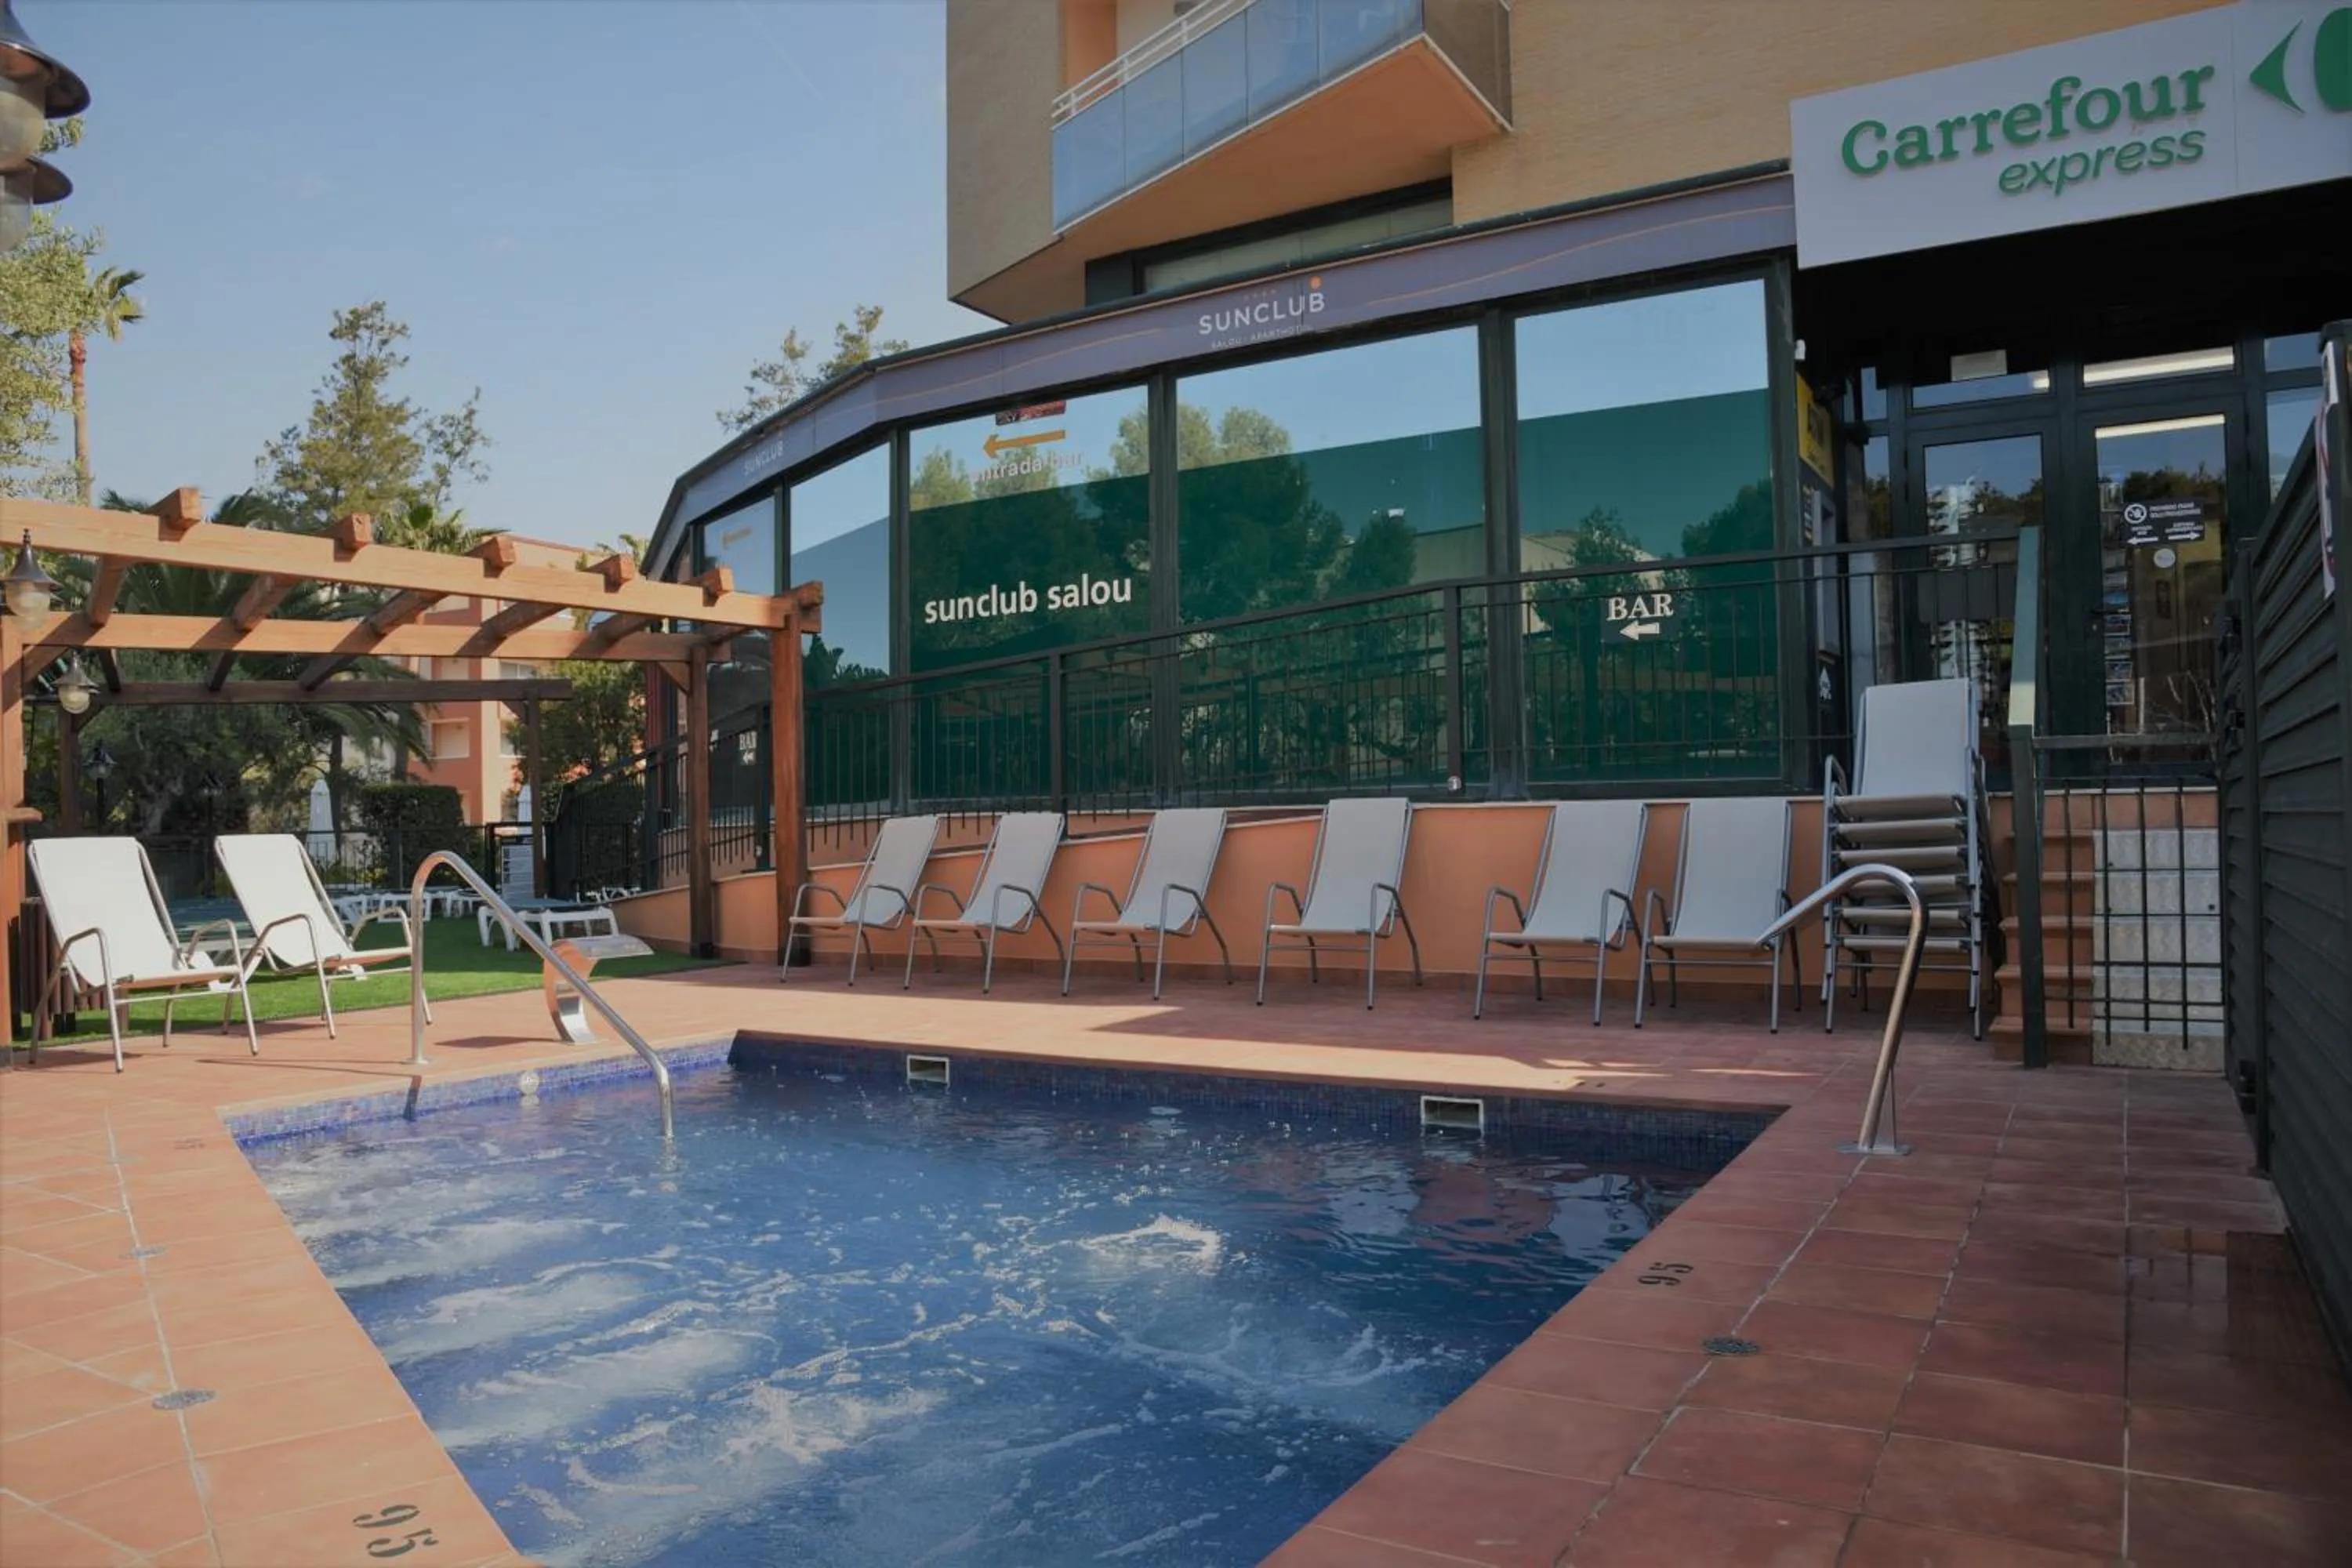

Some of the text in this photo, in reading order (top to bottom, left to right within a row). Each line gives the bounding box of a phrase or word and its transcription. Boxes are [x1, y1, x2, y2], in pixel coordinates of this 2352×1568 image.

[1842, 64, 2215, 176] Carrefour
[1998, 129, 2206, 196] express
[1199, 292, 1326, 335] SUNCLUB
[925, 573, 1131, 623] sunclub salou
[1606, 593, 1675, 621] BAR
[1638, 1261, 1693, 1286] 95
[353, 1504, 439, 1557] 95
